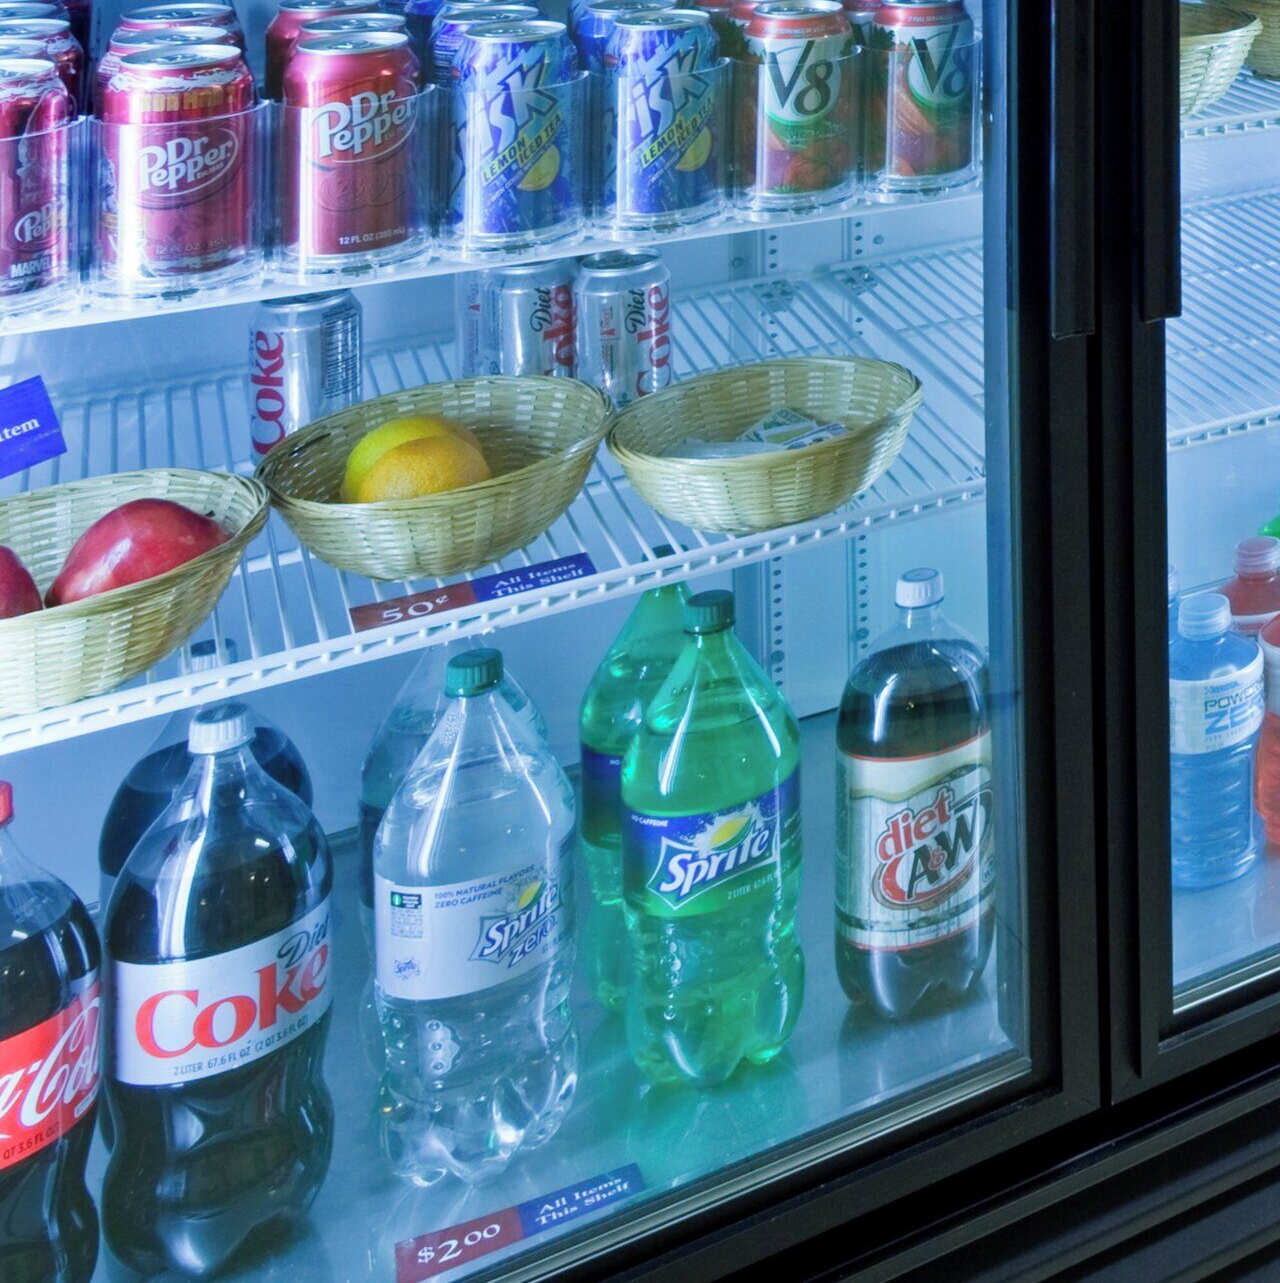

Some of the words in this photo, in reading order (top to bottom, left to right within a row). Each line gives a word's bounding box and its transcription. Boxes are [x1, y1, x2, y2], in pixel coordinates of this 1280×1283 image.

[763, 39, 834, 115] V8
[909, 24, 972, 98] V8
[310, 97, 415, 159] Pepper
[350, 90, 396, 123] Dr
[138, 138, 231, 191] Pepper
[167, 135, 209, 165] Dr
[482, 135, 527, 186] LEMON
[641, 119, 684, 167] LEMON
[338, 235, 350, 245] 12
[351, 235, 361, 244] FL
[362, 233, 375, 243] OZ
[529, 287, 551, 333] Diet
[624, 288, 647, 335] Diet
[252, 330, 286, 456] Coke
[489, 581, 540, 598] This
[541, 567, 588, 586] Shelf
[493, 574, 520, 589] All
[524, 560, 578, 581] Items
[382, 593, 450, 623] 50¢
[638, 816, 669, 828] CAFFEINE
[877, 787, 953, 860] diet
[658, 821, 769, 900] Sprite
[905, 797, 981, 900] A&W
[434, 899, 459, 909] ZERO
[459, 886, 503, 906] CAFFEINE
[455, 880, 498, 897] NATURAL
[478, 882, 559, 958] Sprite
[135, 943, 329, 1059] Coke
[180, 1062, 204, 1075] LITER
[207, 1056, 227, 1069] 67.6
[228, 1051, 238, 1062] FL
[534, 1205, 579, 1226] This
[582, 1180, 631, 1208] Shelf
[538, 1196, 567, 1215] All
[573, 1176, 623, 1201] Items
